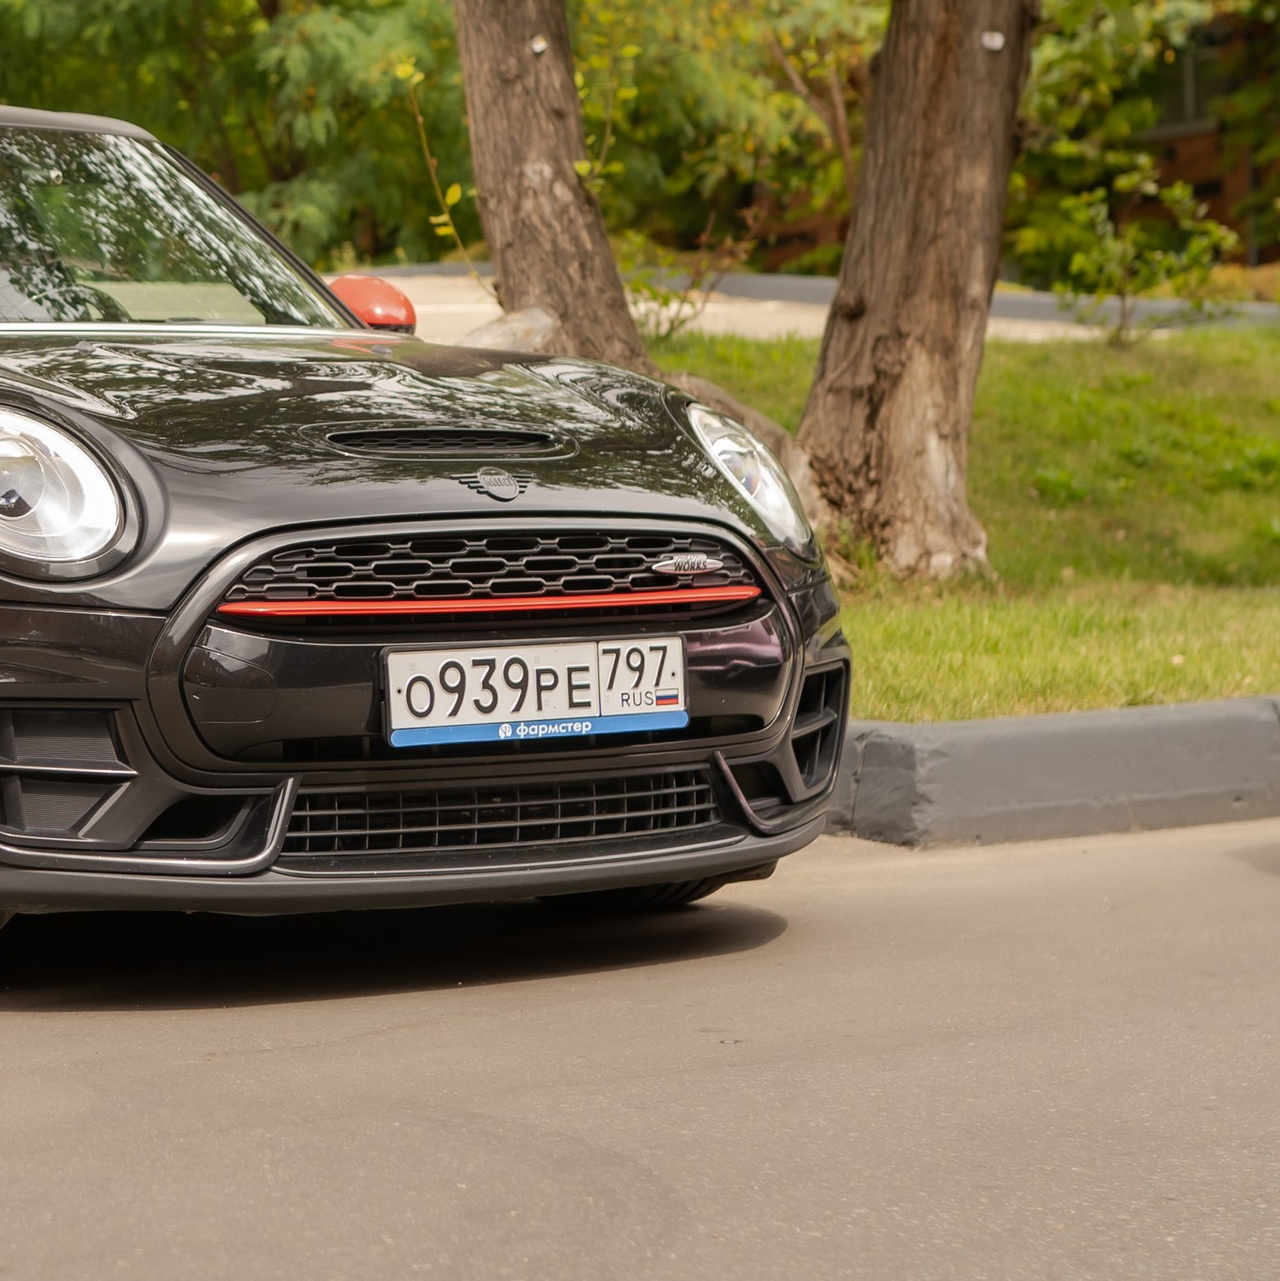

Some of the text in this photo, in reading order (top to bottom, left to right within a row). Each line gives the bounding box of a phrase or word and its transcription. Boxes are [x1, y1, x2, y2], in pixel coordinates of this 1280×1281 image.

[675, 562, 707, 572] WORKS
[602, 645, 668, 690] 797
[621, 691, 654, 708] RUS
[516, 721, 592, 740] фармстер
